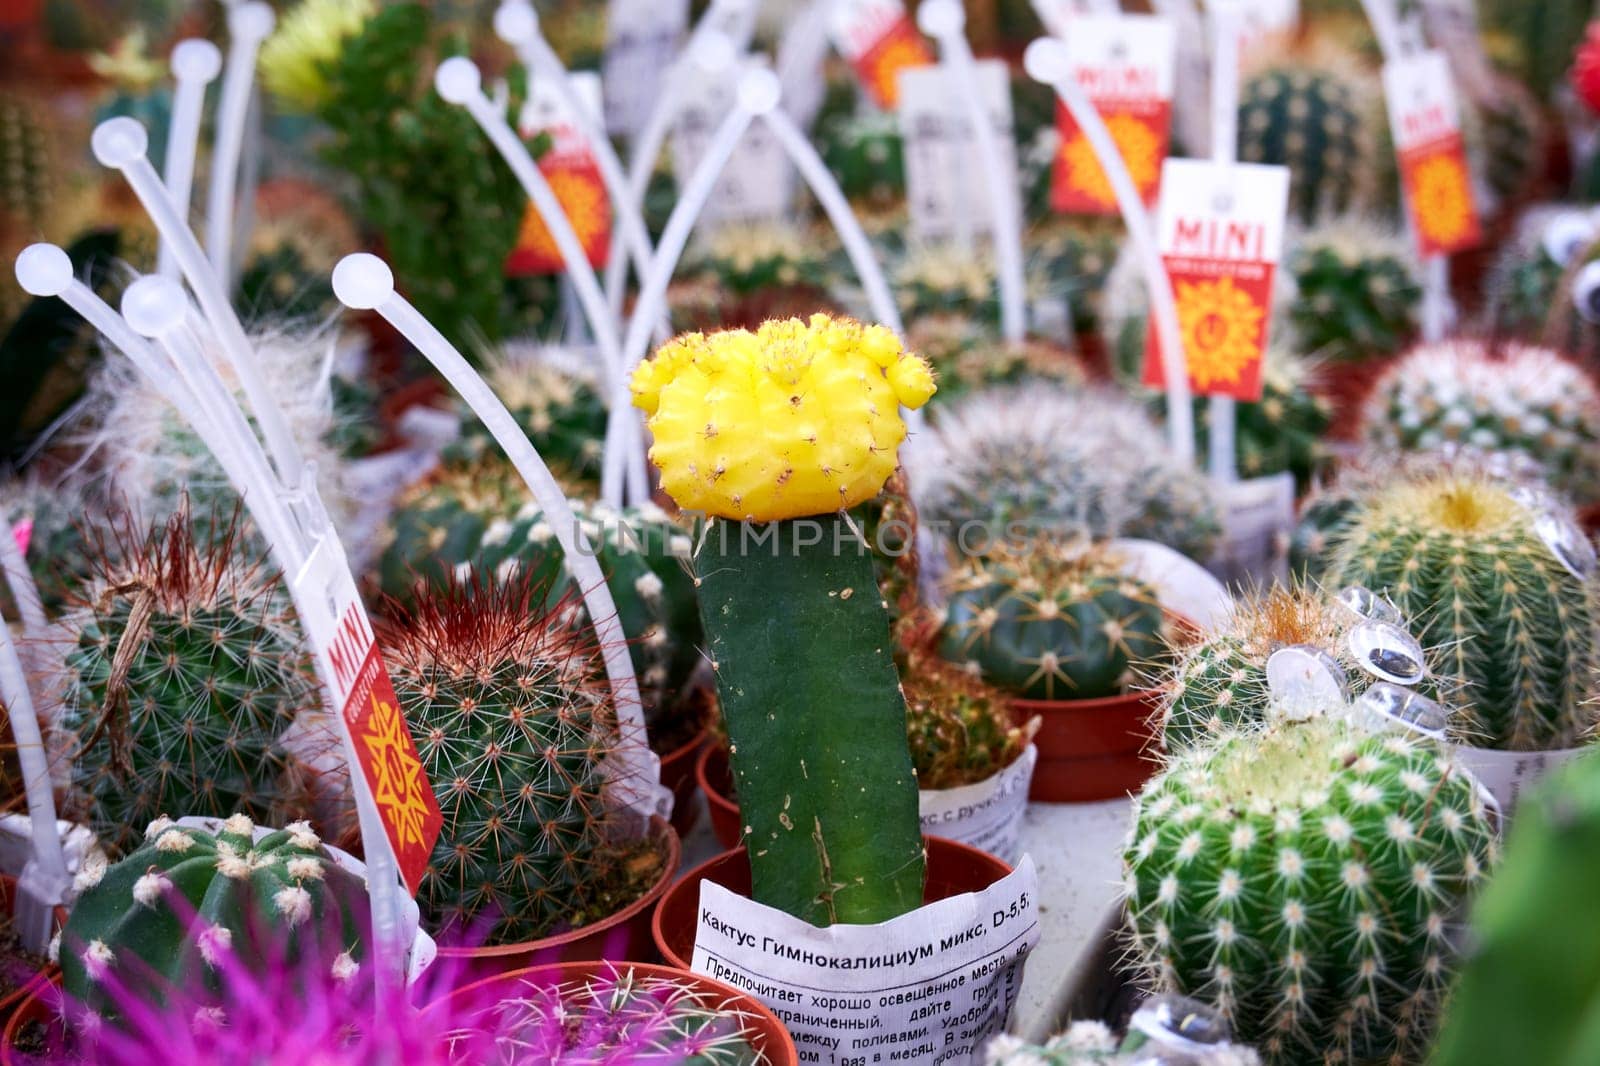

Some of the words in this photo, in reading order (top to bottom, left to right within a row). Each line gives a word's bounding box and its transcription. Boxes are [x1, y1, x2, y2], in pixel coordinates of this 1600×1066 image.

[1174, 216, 1267, 260] MINI
[327, 600, 371, 697] MINI
[348, 656, 380, 724] COLLECTION
[702, 906, 756, 947] Кактус
[762, 937, 934, 971] Гимнокалициум
[940, 923, 988, 953] микс,
[705, 956, 803, 1004] Предпочитает
[811, 995, 872, 1014] хорошо
[879, 975, 966, 1008] освещенное
[909, 1000, 953, 1023] дайте
[790, 1031, 841, 1051] между
[852, 1026, 930, 1050] поливами.
[829, 1052, 836, 1064] 1
[873, 1052, 882, 1064] в
[890, 1043, 938, 1061] месяц.
